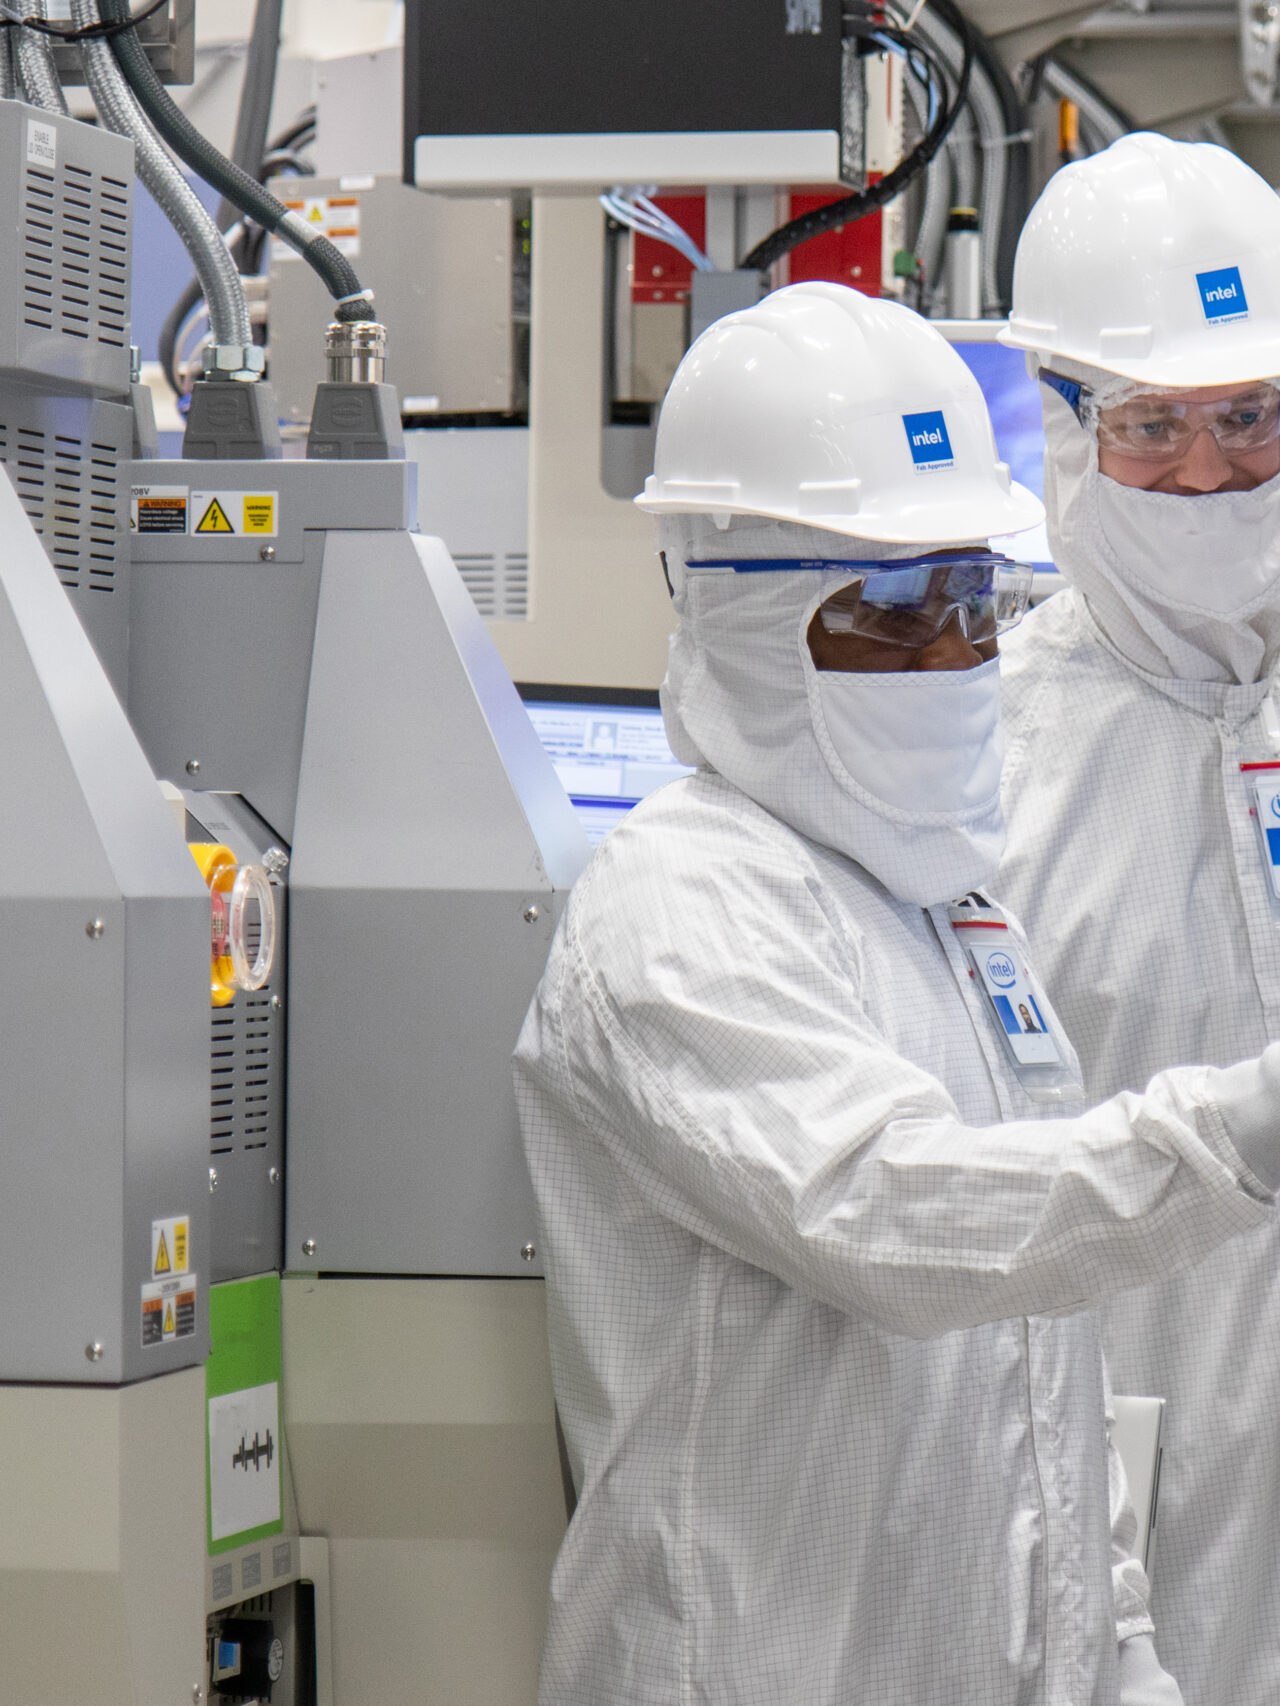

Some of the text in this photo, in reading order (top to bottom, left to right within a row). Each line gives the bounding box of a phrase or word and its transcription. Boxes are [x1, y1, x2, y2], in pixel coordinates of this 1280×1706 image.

[1205, 283, 1238, 302] intel
[1220, 313, 1248, 322] Approved
[911, 427, 944, 446] intel
[927, 461, 954, 470] Approved
[988, 960, 1013, 977] intel
